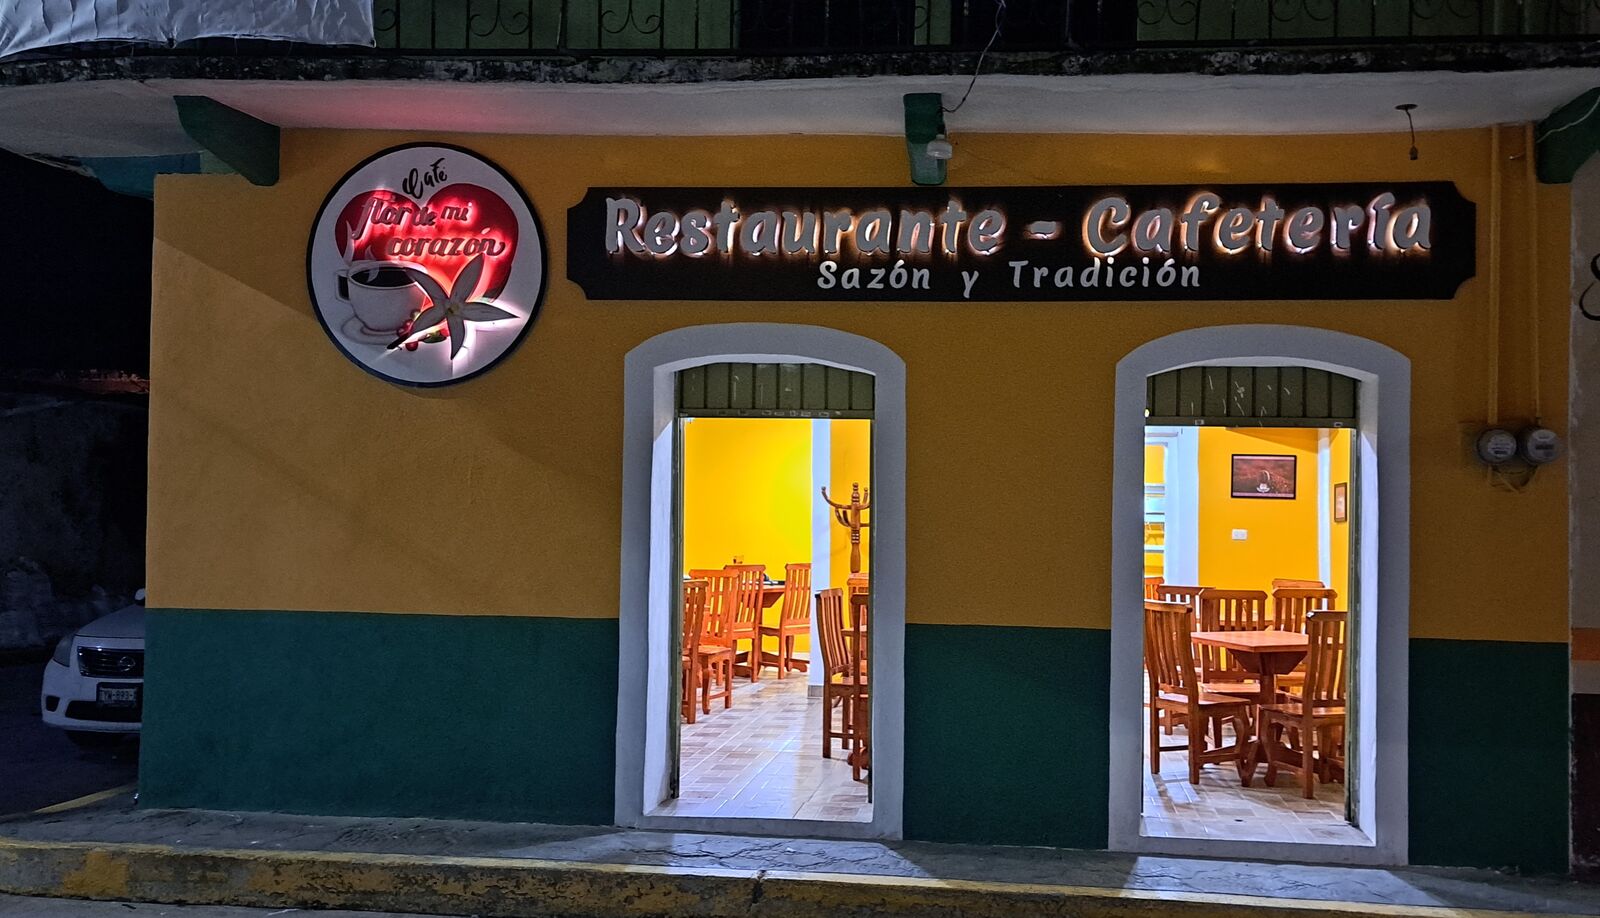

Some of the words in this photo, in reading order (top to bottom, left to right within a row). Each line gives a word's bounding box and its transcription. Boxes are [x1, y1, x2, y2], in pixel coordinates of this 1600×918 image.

[413, 205, 437, 226] de
[440, 201, 473, 221] mi
[605, 197, 1006, 258] Restaurante
[1027, 220, 1058, 239] -
[1082, 191, 1434, 257] Cafetería
[387, 227, 506, 257] corazón
[817, 259, 931, 290] Sazón
[961, 270, 980, 299] y
[1008, 257, 1201, 289] Tradición
